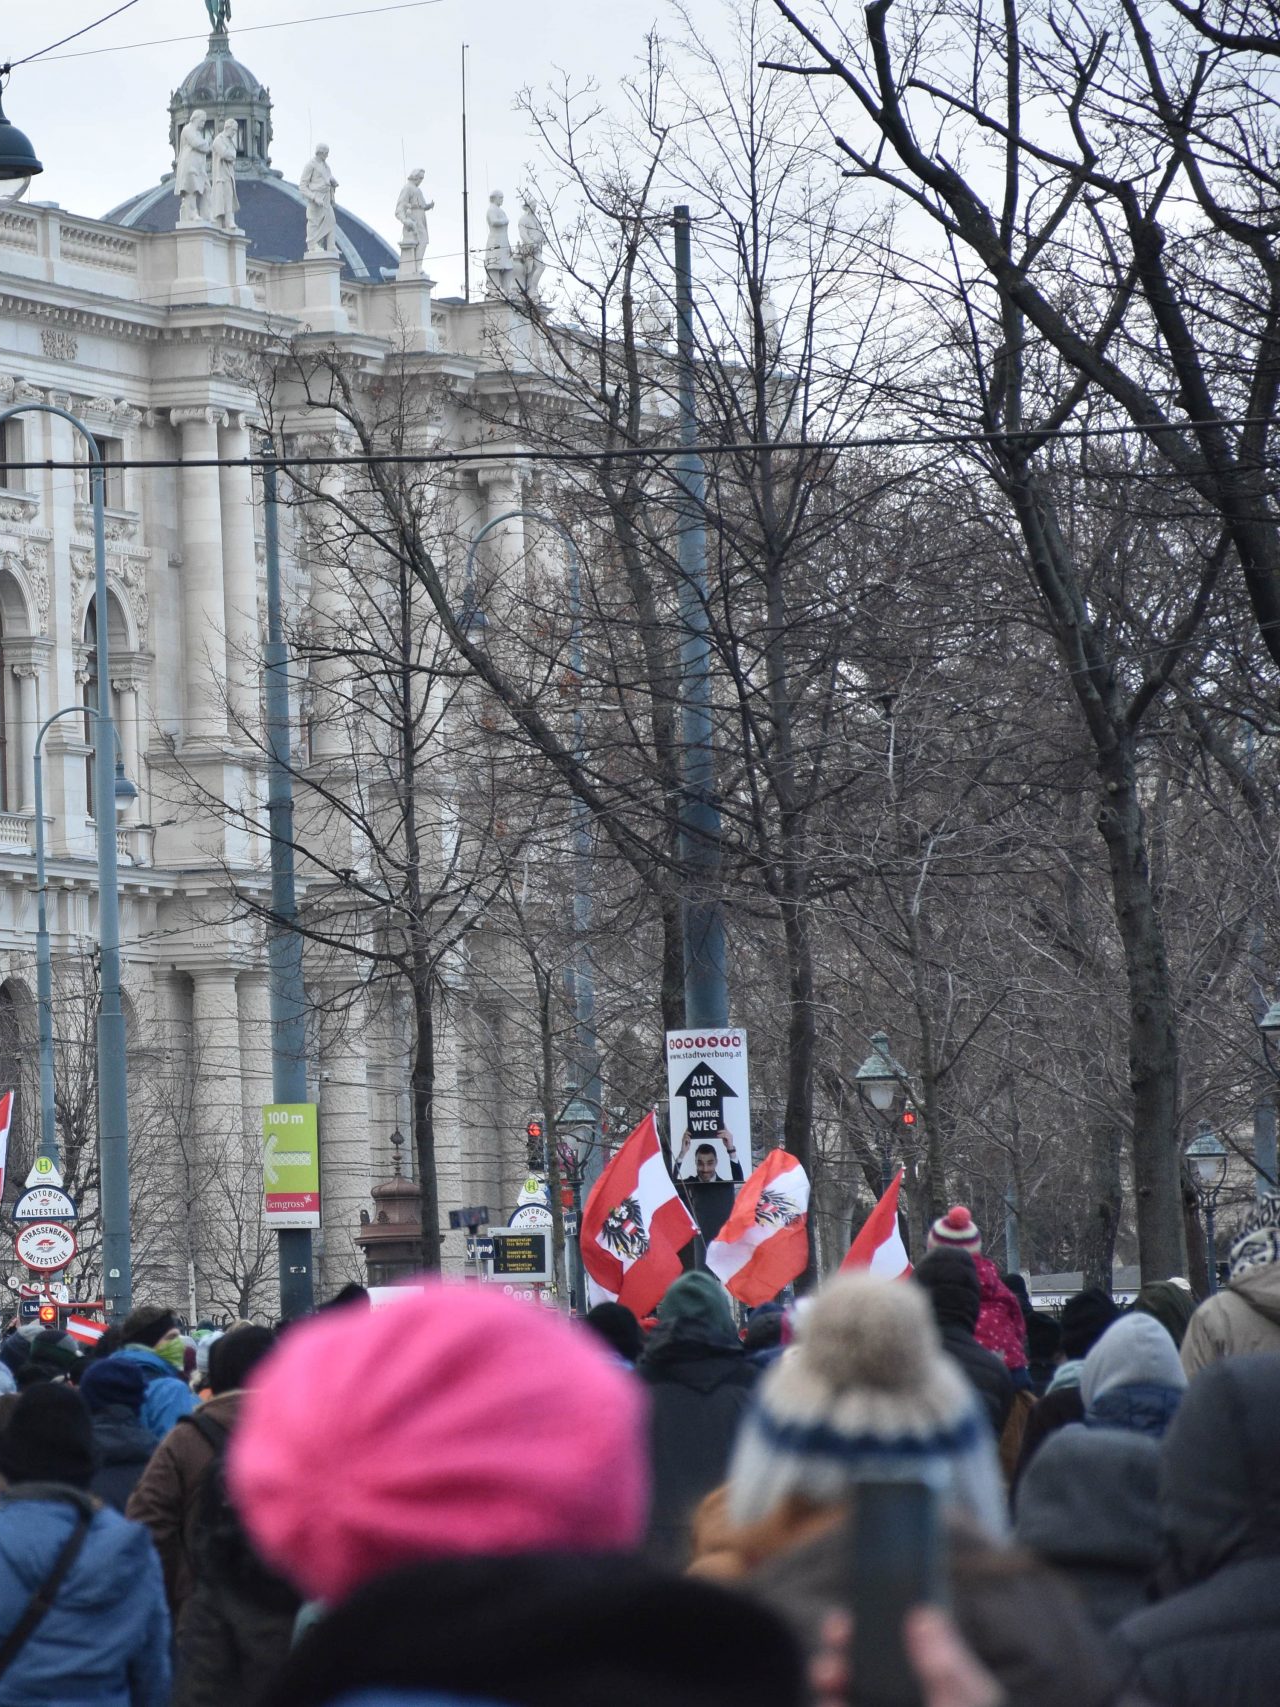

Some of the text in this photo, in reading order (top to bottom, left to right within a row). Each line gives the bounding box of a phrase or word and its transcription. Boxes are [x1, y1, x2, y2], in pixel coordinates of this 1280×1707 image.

[691, 1075, 715, 1087] AUF
[690, 1088, 717, 1098] DAUER
[268, 1112, 304, 1124] 100 m
[689, 1110, 720, 1118] RICHTIGE
[692, 1120, 718, 1131] WEG
[39, 1160, 49, 1171] H
[28, 1190, 63, 1202] AUTOBUS
[266, 1200, 305, 1211] Gerngross
[21, 1208, 69, 1216] HALTESTELLE
[519, 1208, 549, 1219] AUTOBUS
[22, 1226, 70, 1244] STRASSENBAHN
[24, 1250, 68, 1265] HALTESTELLE
